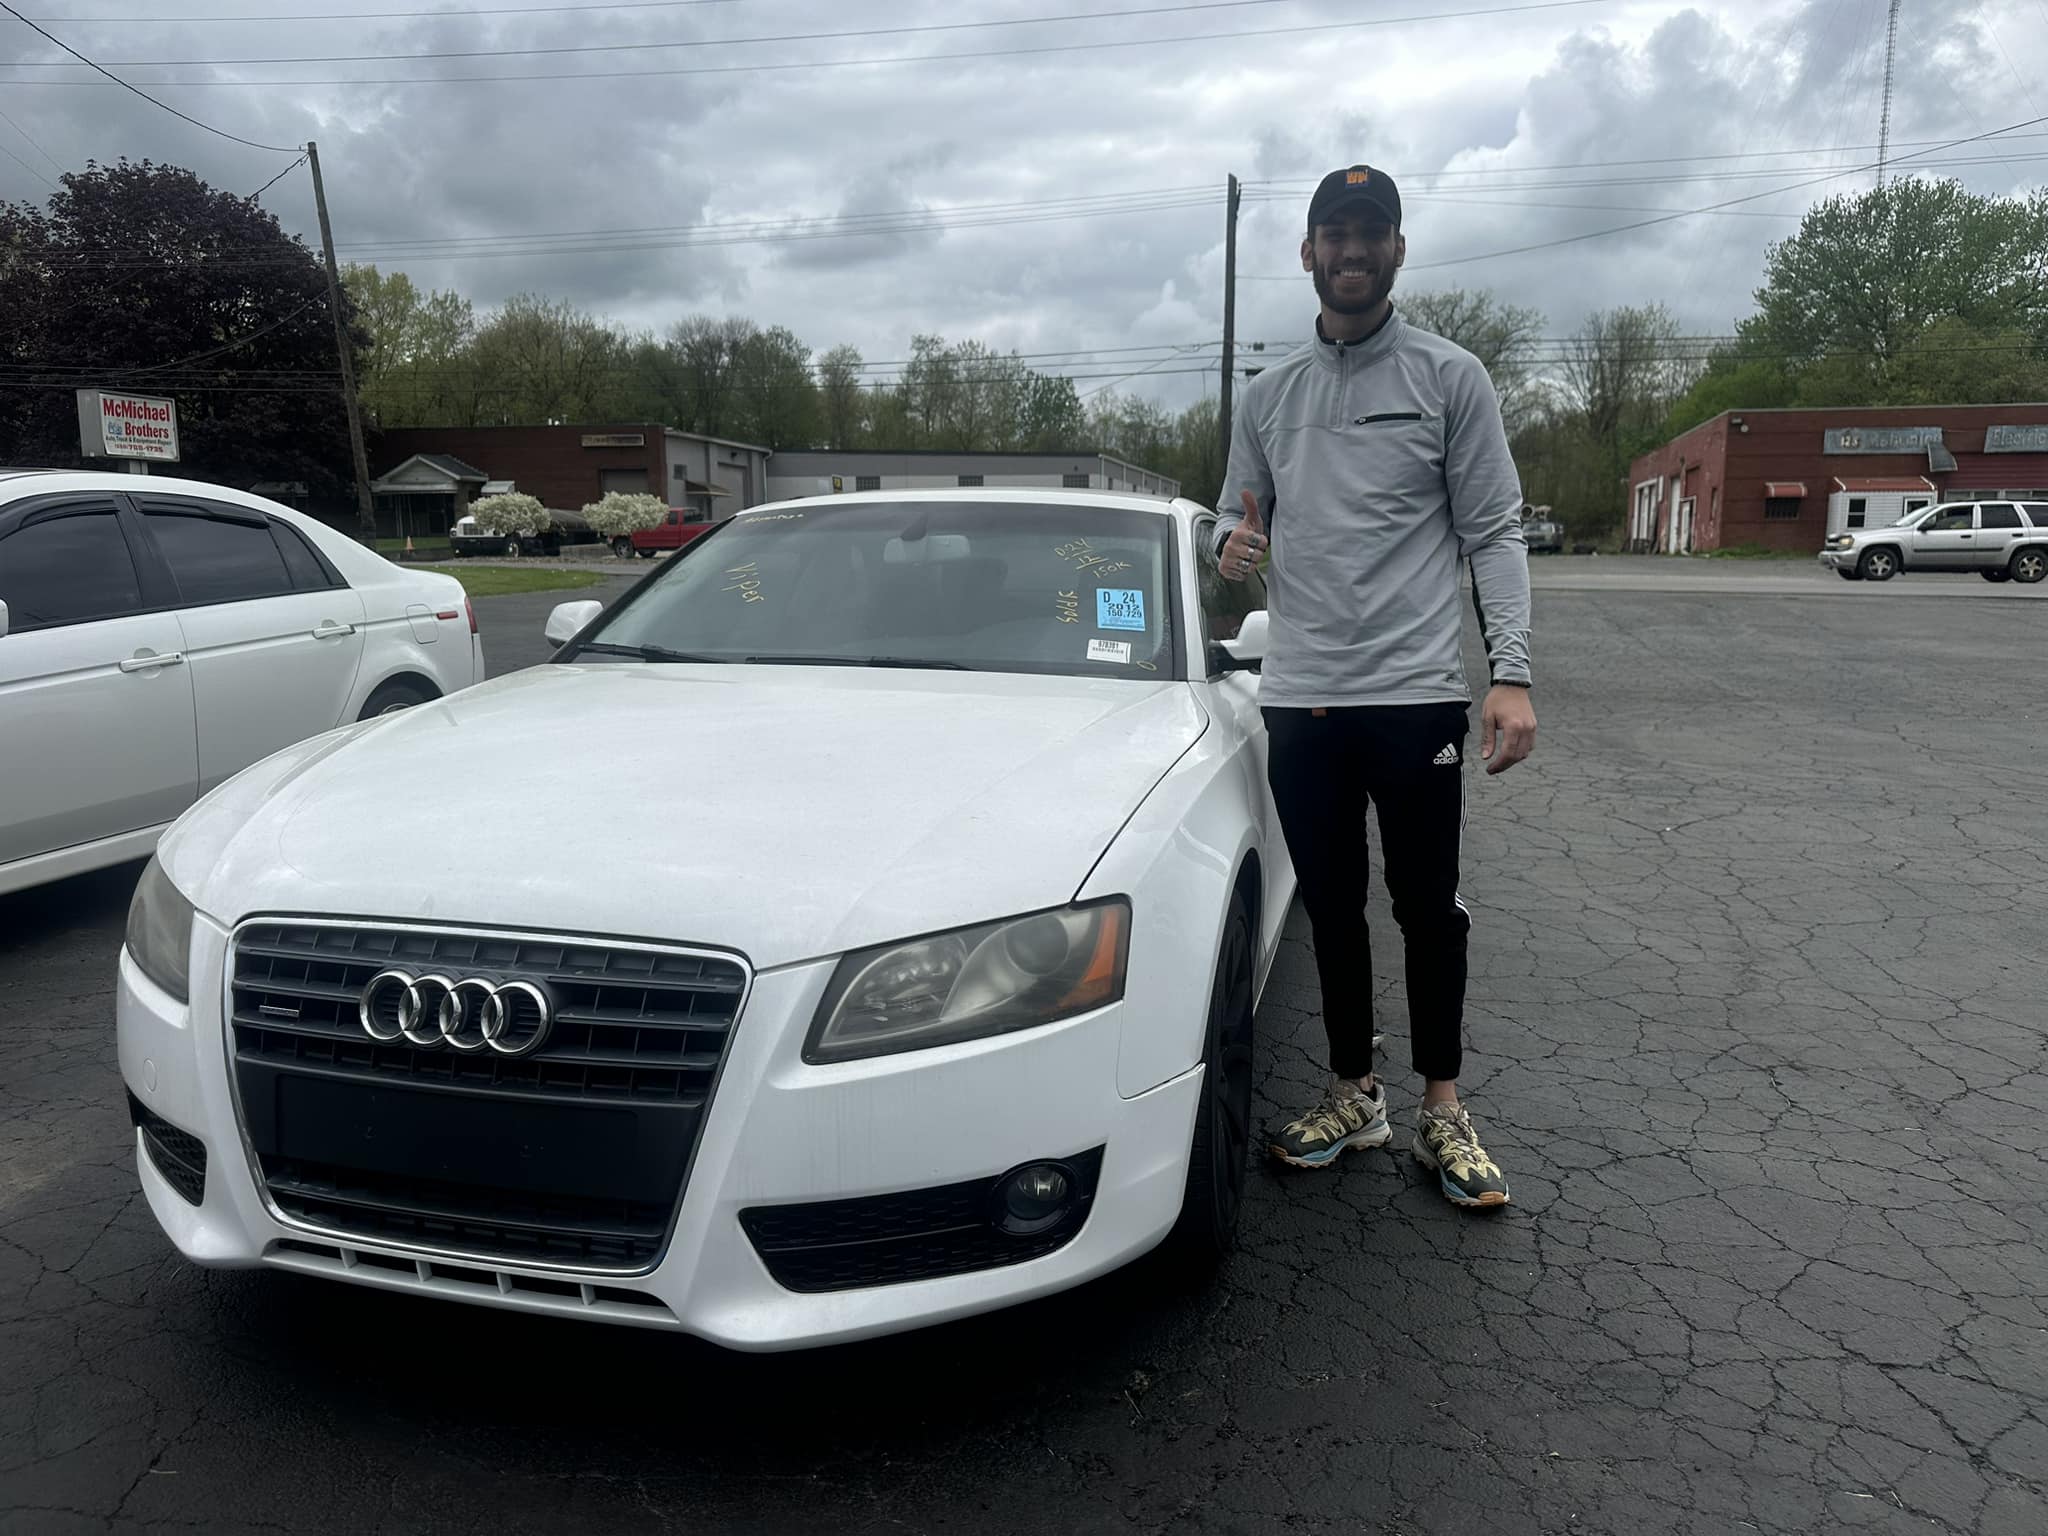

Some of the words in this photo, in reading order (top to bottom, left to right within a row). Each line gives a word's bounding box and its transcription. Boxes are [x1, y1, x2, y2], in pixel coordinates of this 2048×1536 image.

[103, 398, 170, 422] McMichael
[124, 422, 169, 439] Brothers
[1103, 592, 1111, 603] D
[1122, 592, 1136, 604] 24
